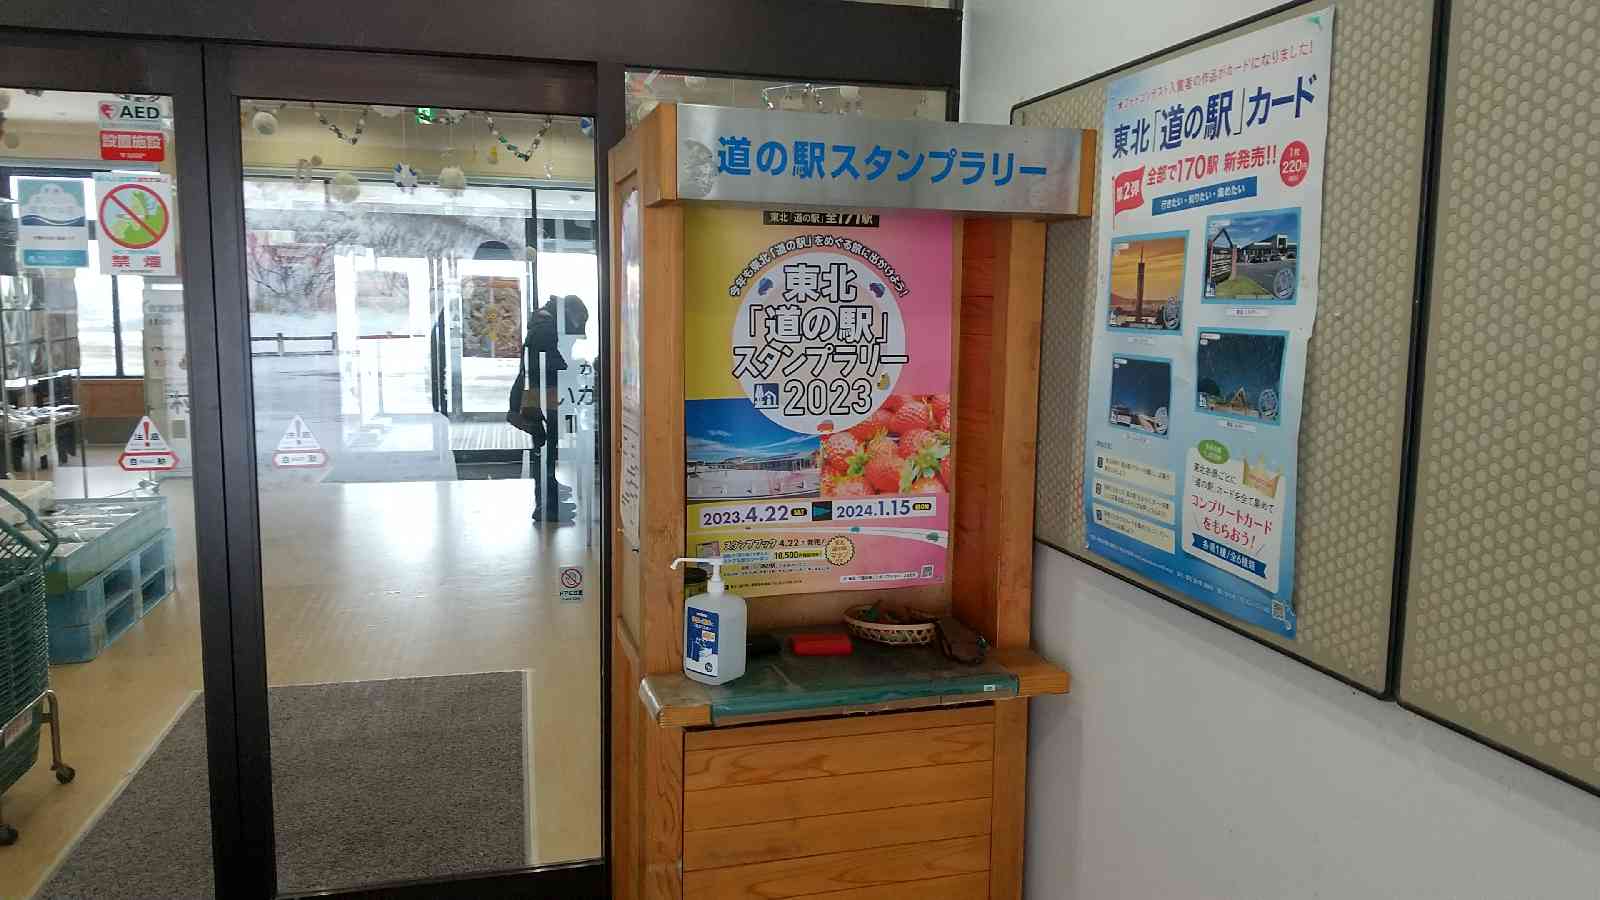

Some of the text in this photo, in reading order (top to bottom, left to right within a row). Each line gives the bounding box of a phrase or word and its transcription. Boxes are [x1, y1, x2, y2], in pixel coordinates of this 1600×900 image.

[119, 105, 161, 119] AED
[717, 136, 1047, 187] 道の駅スタンプラリー
[782, 262, 858, 303] 東北
[748, 303, 889, 344] 「道の駅」
[731, 343, 910, 380] スタンプラリー
[783, 378, 873, 417] 2023
[703, 504, 790, 526] 2023.4.22
[836, 499, 912, 519] 2024.1.15
